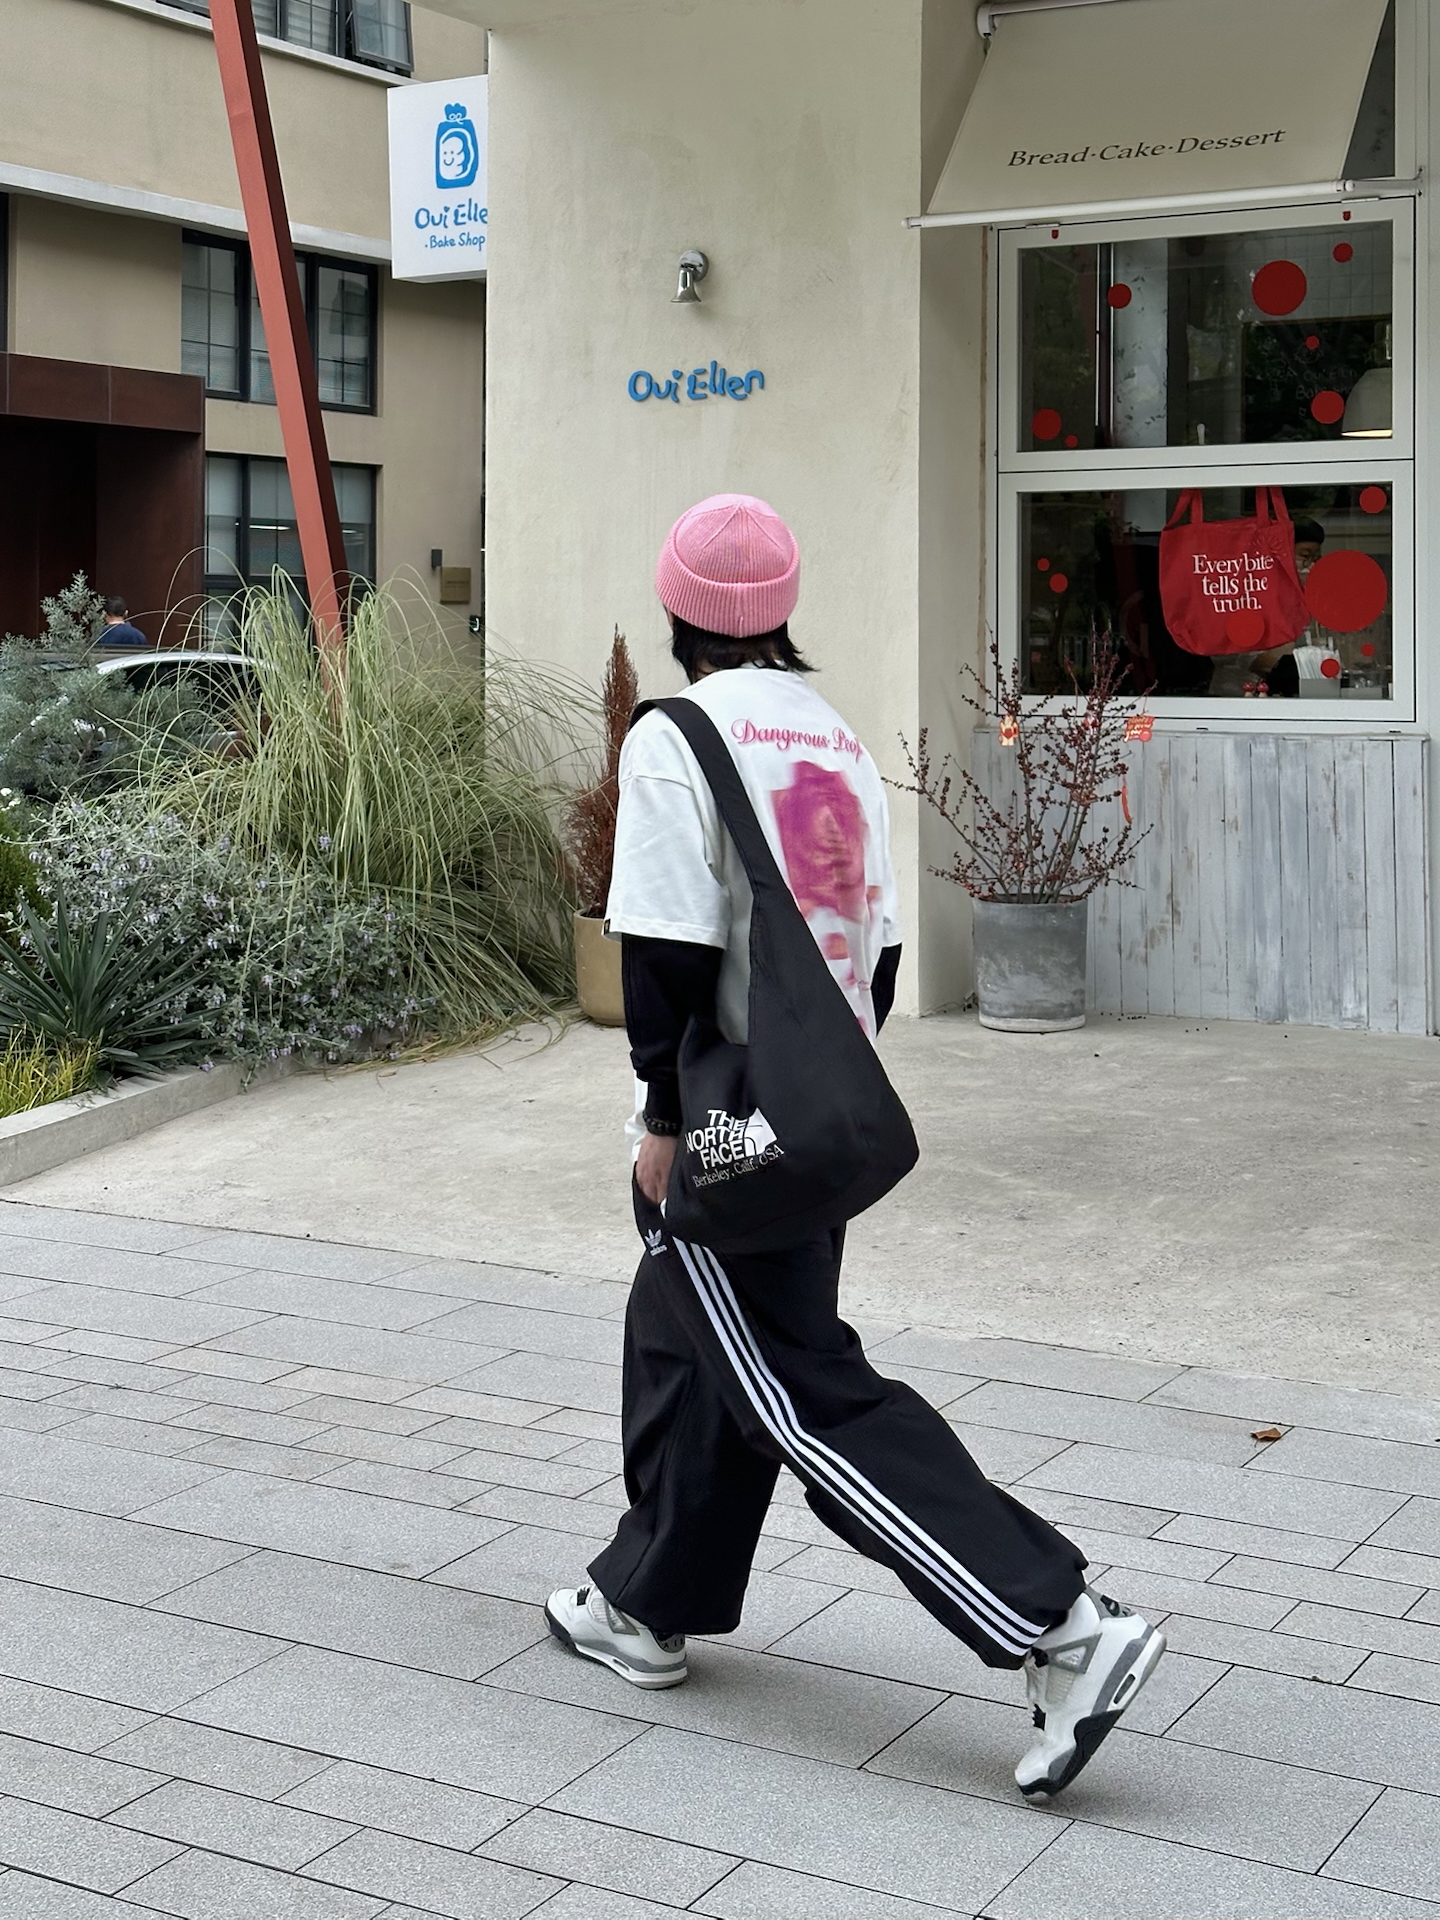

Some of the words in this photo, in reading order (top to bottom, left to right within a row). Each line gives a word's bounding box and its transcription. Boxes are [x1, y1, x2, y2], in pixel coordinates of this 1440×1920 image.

[414, 205, 450, 229] Oui
[458, 231, 486, 252] Shop
[628, 369, 683, 403] Oui
[686, 360, 765, 400] Ellen
[1192, 554, 1243, 577] Every
[1243, 551, 1274, 572] bite
[1201, 575, 1239, 596] tells
[1243, 573, 1269, 592] the
[1212, 592, 1262, 613] truth.
[731, 717, 829, 751] Dangerous
[707, 1109, 748, 1131] THE
[684, 1125, 745, 1154] NORTH
[699, 1139, 745, 1170] FACE
[759, 1144, 785, 1165] USA
